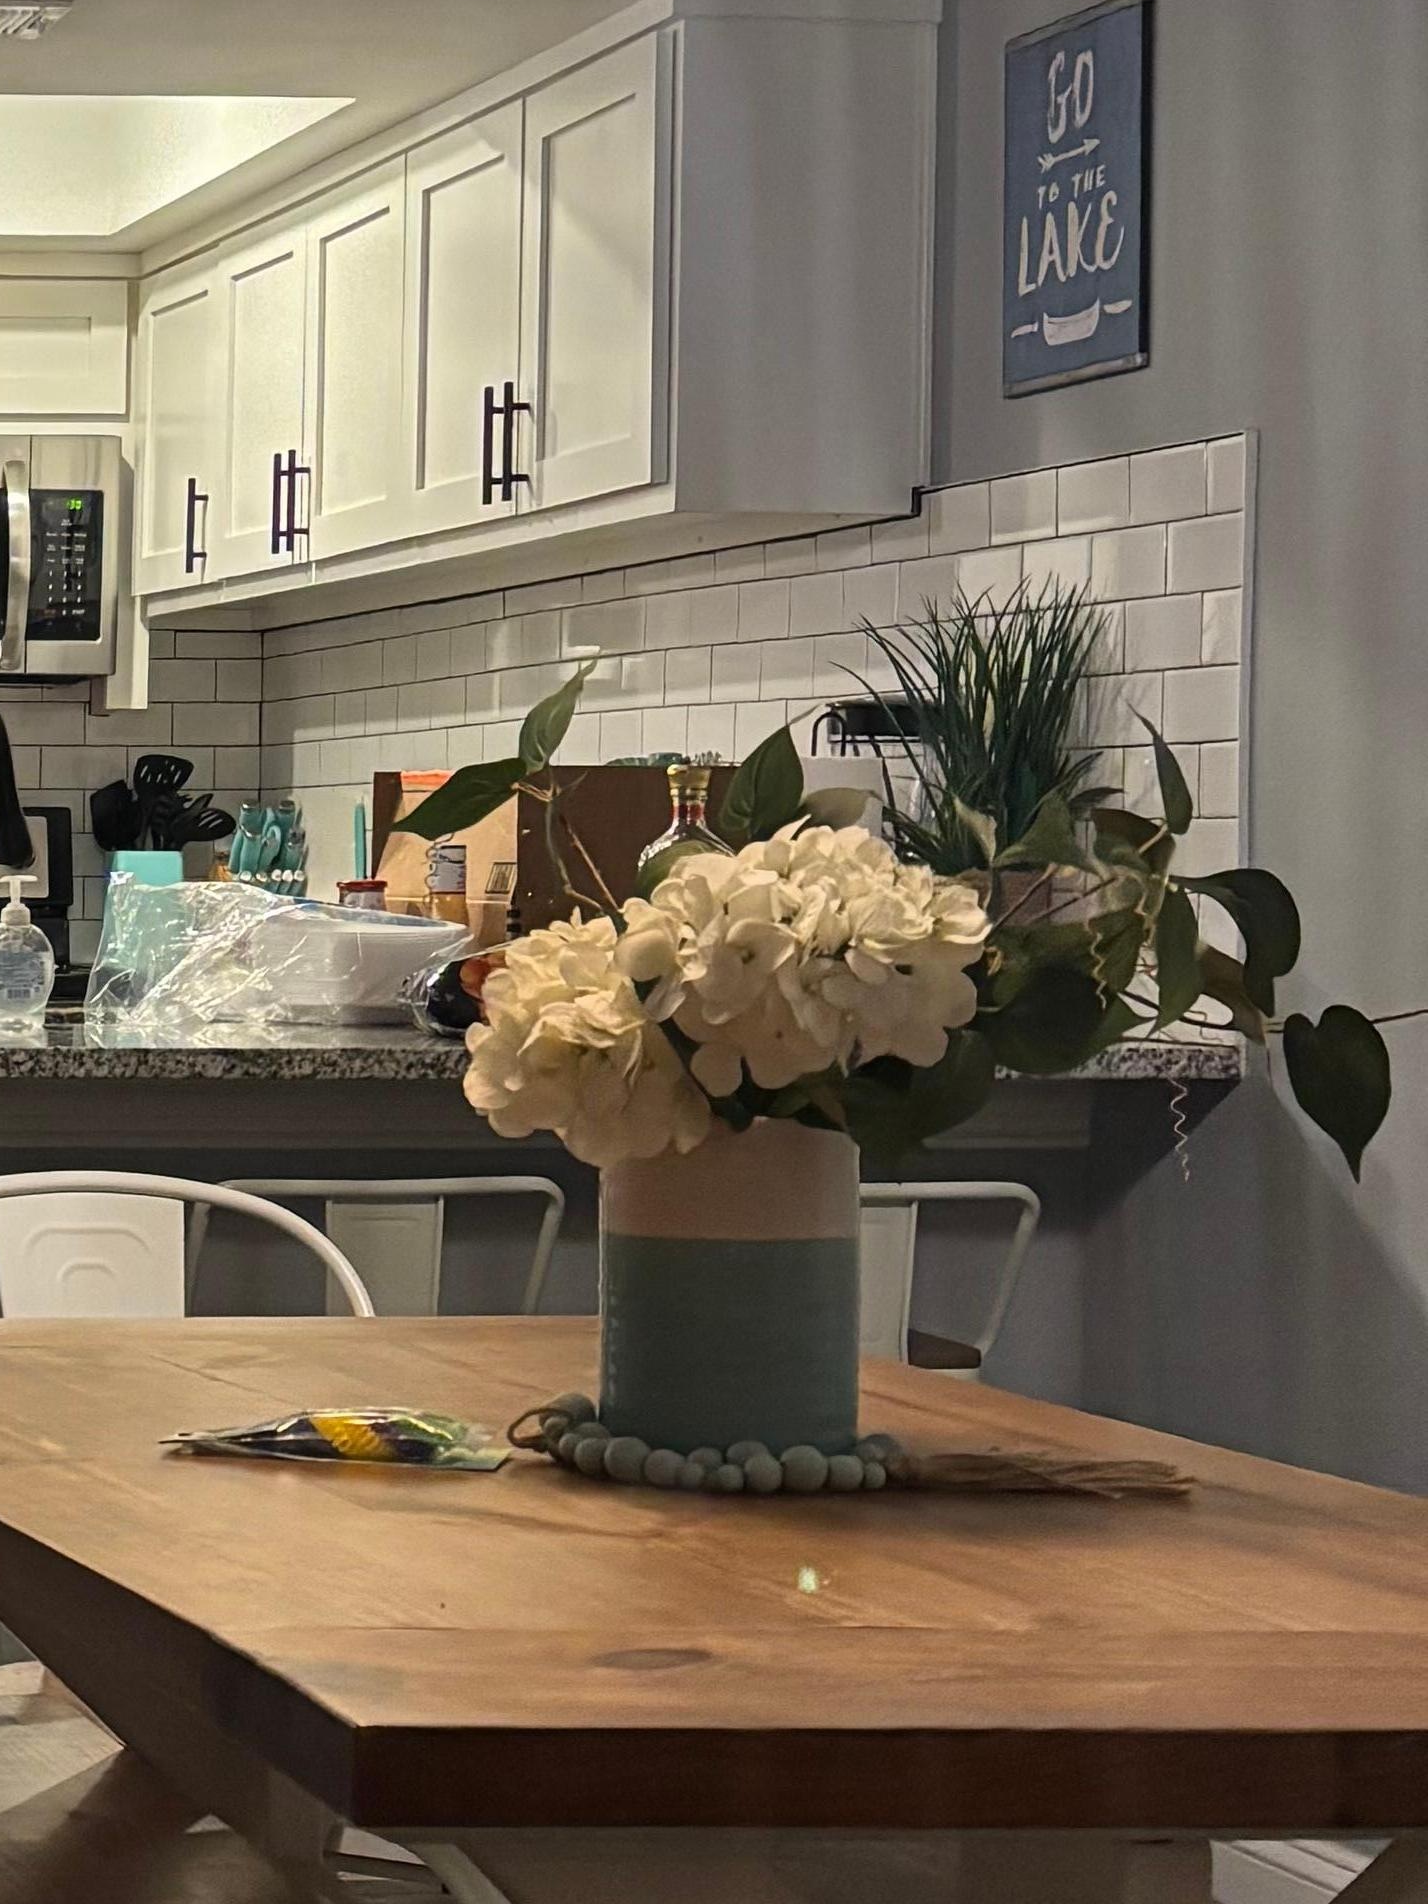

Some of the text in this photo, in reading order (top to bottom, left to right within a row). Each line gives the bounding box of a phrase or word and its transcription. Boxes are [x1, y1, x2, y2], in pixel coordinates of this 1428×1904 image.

[1047, 49, 1094, 144] GO
[1038, 163, 1106, 209] TO THE
[1018, 190, 1125, 297] LAKE
